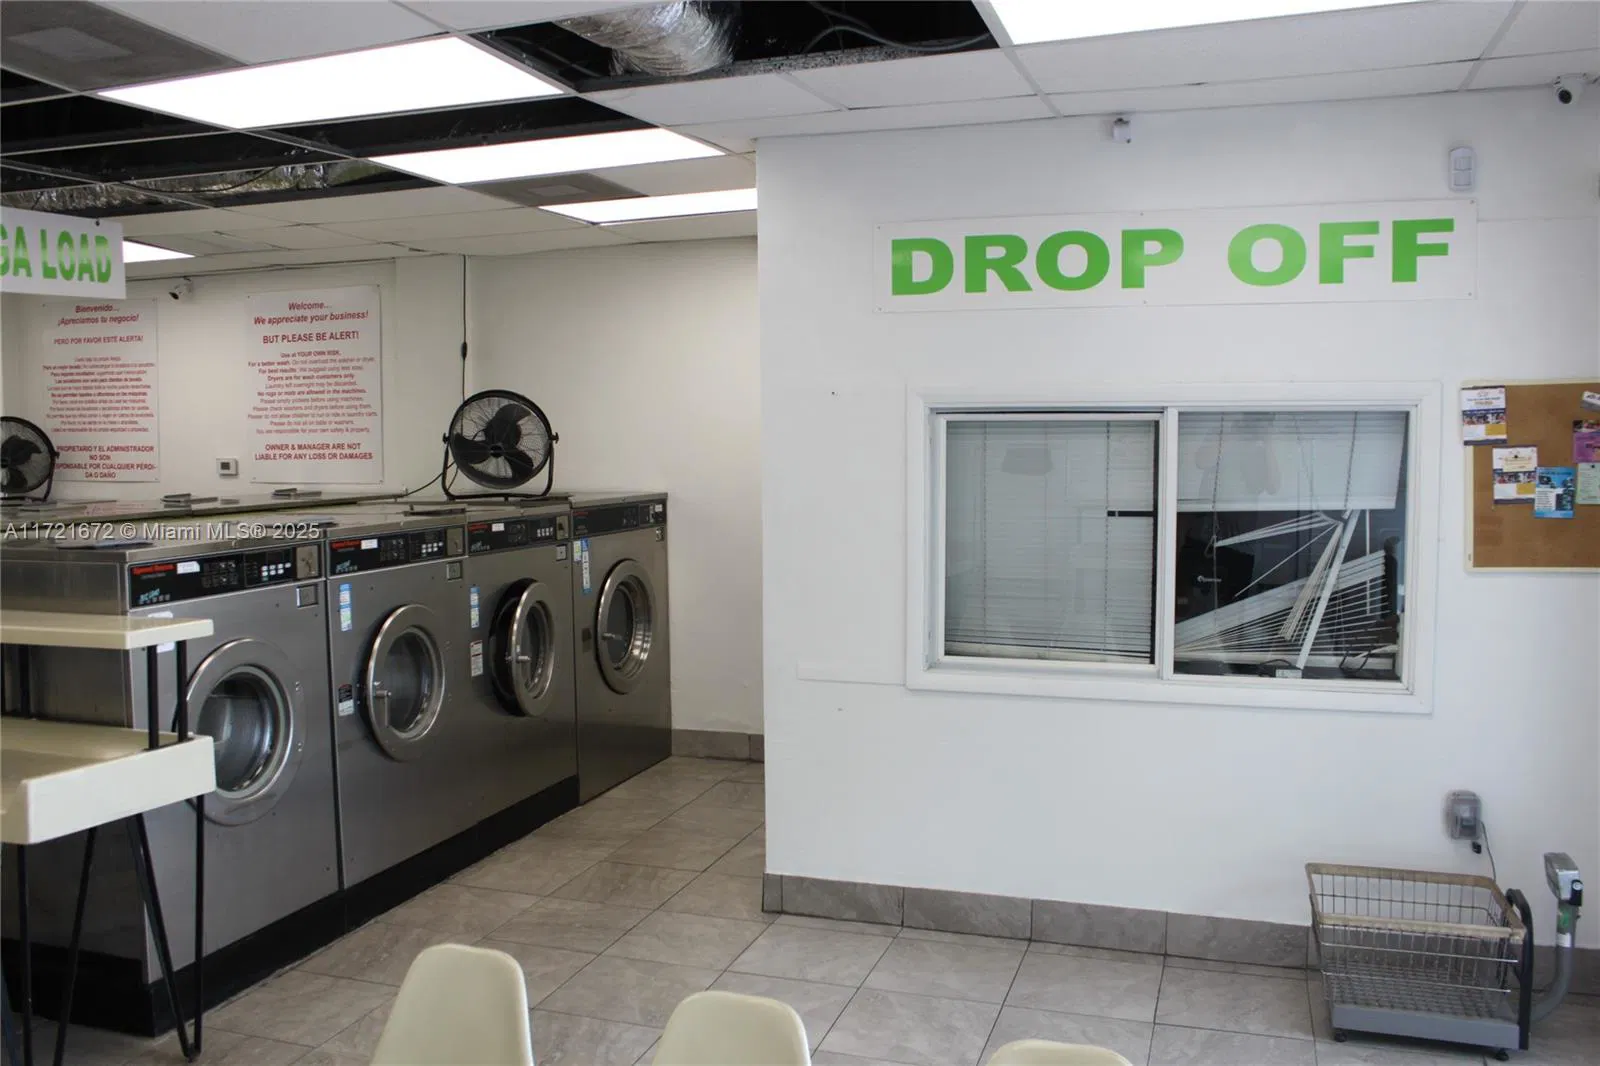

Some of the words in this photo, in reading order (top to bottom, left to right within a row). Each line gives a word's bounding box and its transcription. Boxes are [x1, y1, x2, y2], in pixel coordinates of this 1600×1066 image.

[40, 228, 111, 283] LOAD
[891, 228, 1184, 296] DROP
[1227, 218, 1455, 286] OFF
[109, 314, 139, 324] negocio!
[254, 317, 266, 325] We
[268, 315, 308, 326] appreciate
[310, 314, 328, 324] your
[329, 310, 369, 321] business!
[263, 335, 280, 344] BUT
[281, 333, 314, 343] PLEASE
[316, 332, 327, 341] BE
[329, 331, 359, 340] ALERT!
